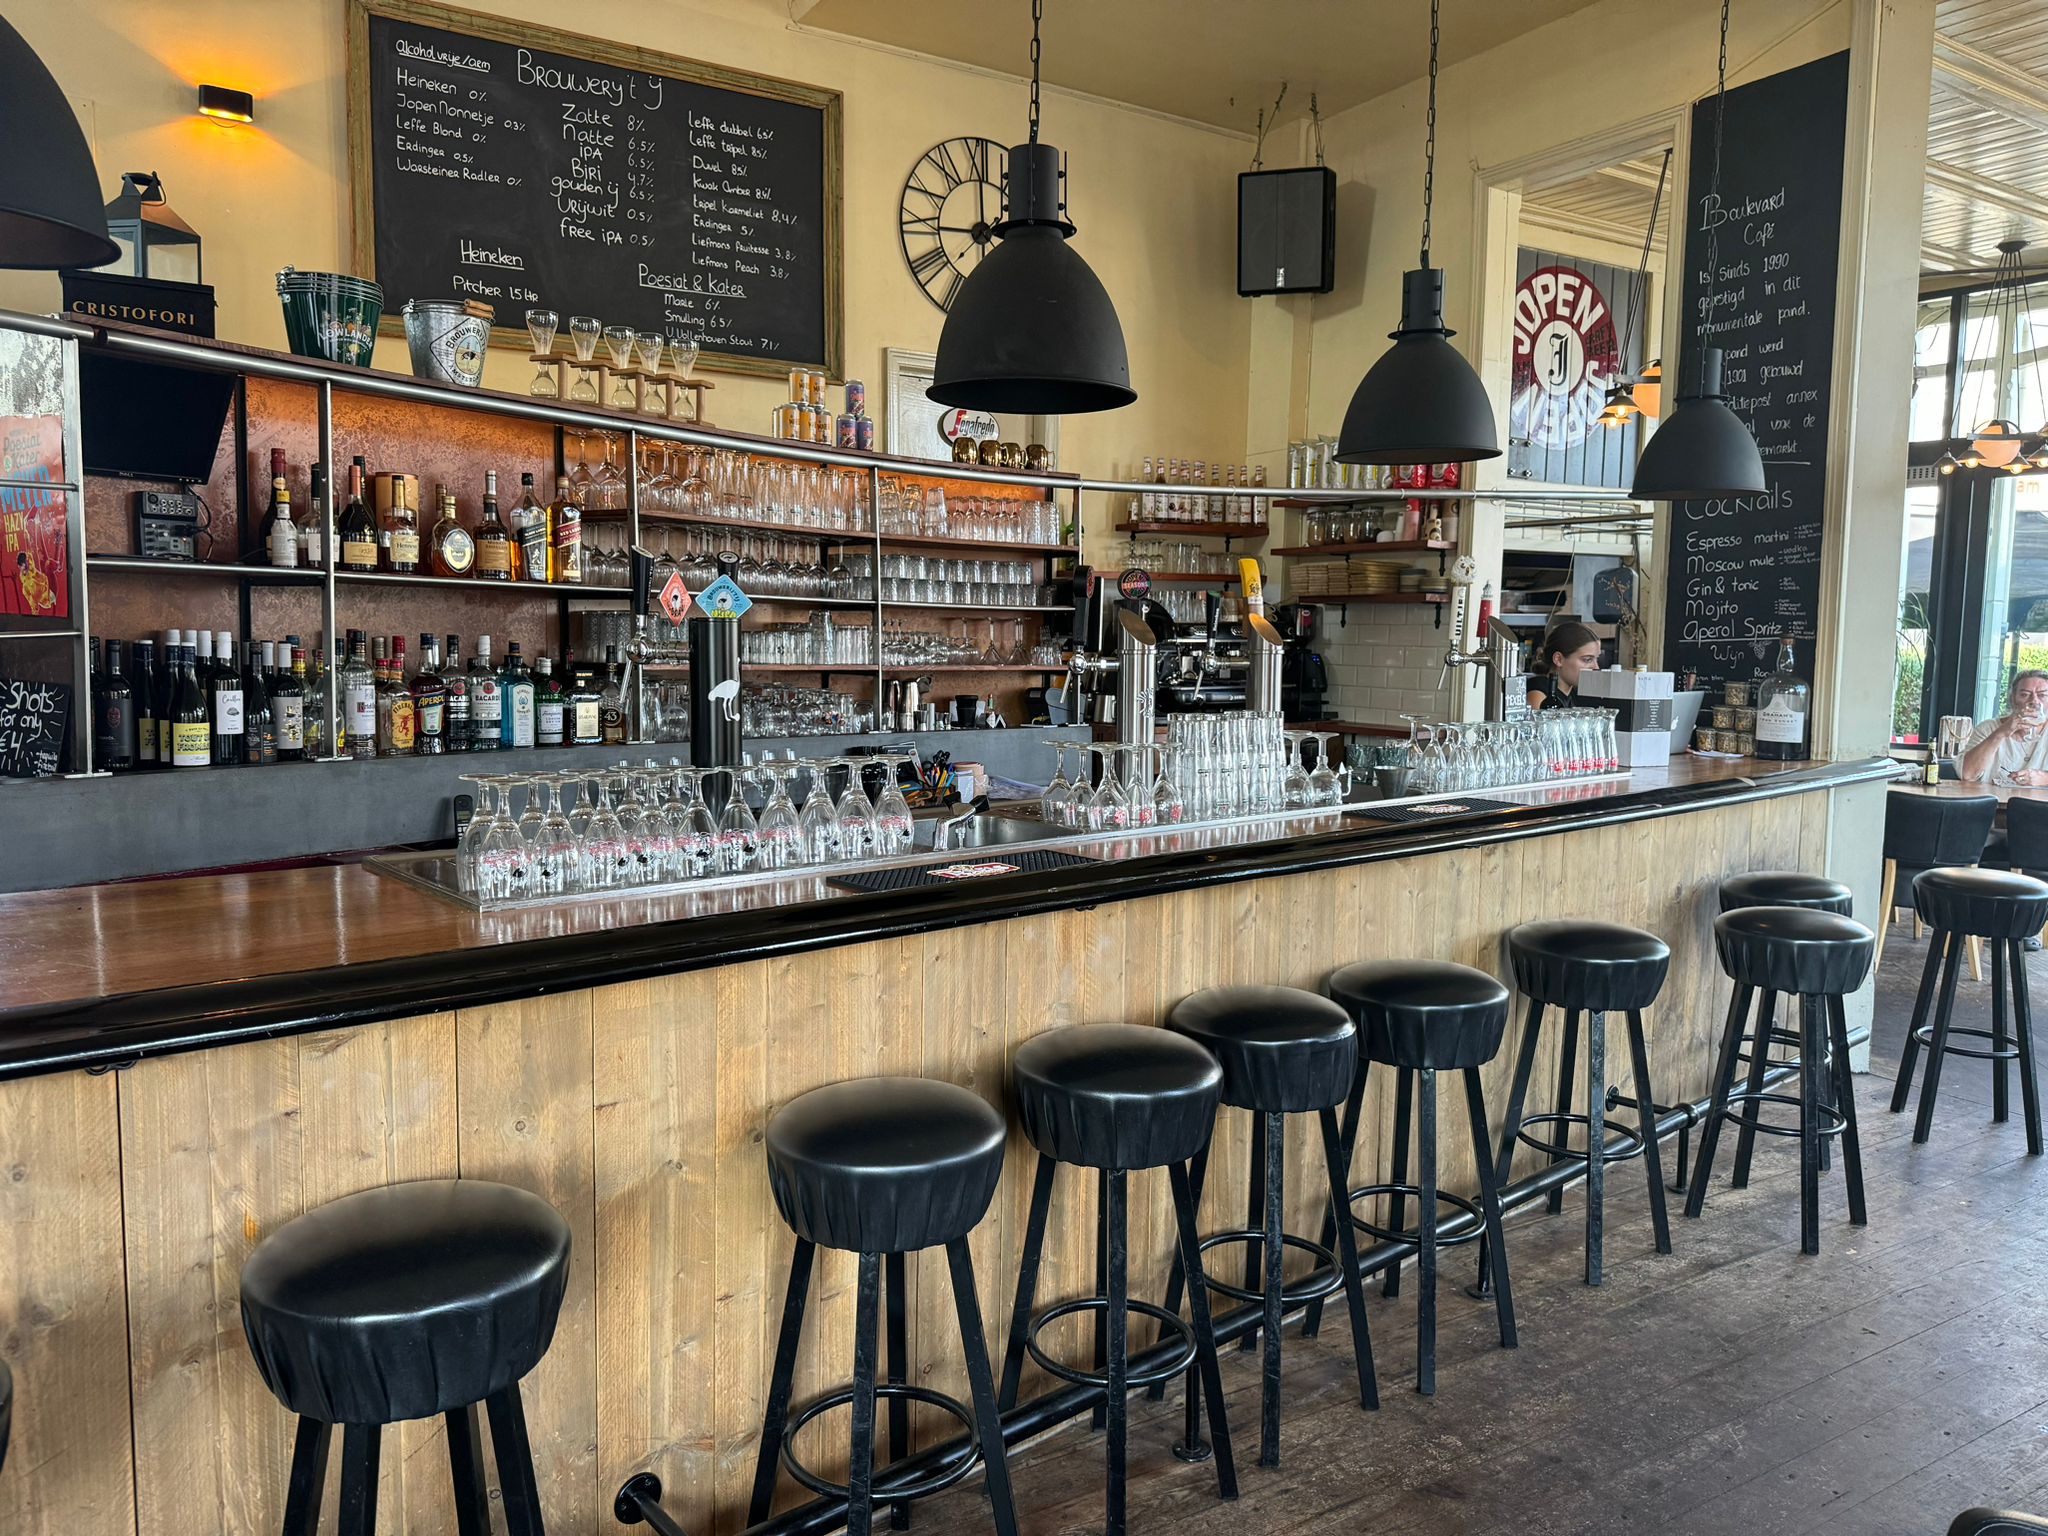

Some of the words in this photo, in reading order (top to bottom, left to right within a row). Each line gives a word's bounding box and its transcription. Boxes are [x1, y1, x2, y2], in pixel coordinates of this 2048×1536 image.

[397, 66, 457, 94] Heineken
[468, 90, 487, 102] 0%
[396, 92, 437, 114] Jopen
[396, 113, 427, 133] Leffe
[433, 121, 462, 139] Blond
[472, 132, 487, 144] 0%
[561, 103, 613, 127] Zatte
[627, 114, 645, 132] 8%
[688, 109, 716, 131] Leffe
[719, 121, 753, 138] dubbel
[396, 134, 445, 158] Erdinger
[689, 130, 717, 149] Leffe
[721, 139, 748, 158] tripel
[396, 156, 460, 178] Warsteiner
[462, 167, 500, 183] Radler
[506, 177, 522, 187] 0%
[693, 155, 722, 173] Duvel
[693, 172, 719, 192] Kwak
[693, 213, 732, 234] Erdinger
[692, 232, 731, 250] Liefmans
[460, 239, 524, 267] Heineken
[692, 251, 728, 270] Liefmans
[735, 259, 760, 275] Peach
[1763, 252, 1791, 273] 1990
[452, 275, 503, 298] Pitcher
[692, 274, 703, 292] &
[708, 272, 746, 297] Kater
[1764, 280, 1777, 297] in
[1782, 276, 1802, 293] dit
[72, 300, 196, 326] CRISTOFORI
[705, 298, 720, 311] 6%
[1513, 272, 1606, 355] JOPEN
[665, 309, 706, 331] Smulling
[729, 334, 754, 347] Stout
[1758, 336, 1784, 354] werd
[1726, 368, 1748, 386] 1901
[1760, 359, 1804, 386] gebouwd
[1785, 389, 1818, 406] annex
[1803, 413, 1817, 428] de
[4, 511, 25, 533] HAZY
[5, 533, 20, 553] IPA
[1686, 530, 1743, 553] Espresso
[1754, 530, 1790, 545] martini
[1686, 555, 1745, 574] Moscow
[1750, 554, 1776, 568] mule
[1686, 577, 1712, 597] Gin
[1715, 575, 1725, 595] &
[1731, 576, 1760, 592] tonic
[1685, 599, 1739, 622] Mojito
[1743, 617, 1784, 640] Spritz
[6, 681, 55, 713] Shots
[0, 708, 17, 728] for
[20, 712, 43, 738] only
[603, 711, 618, 721] 43
